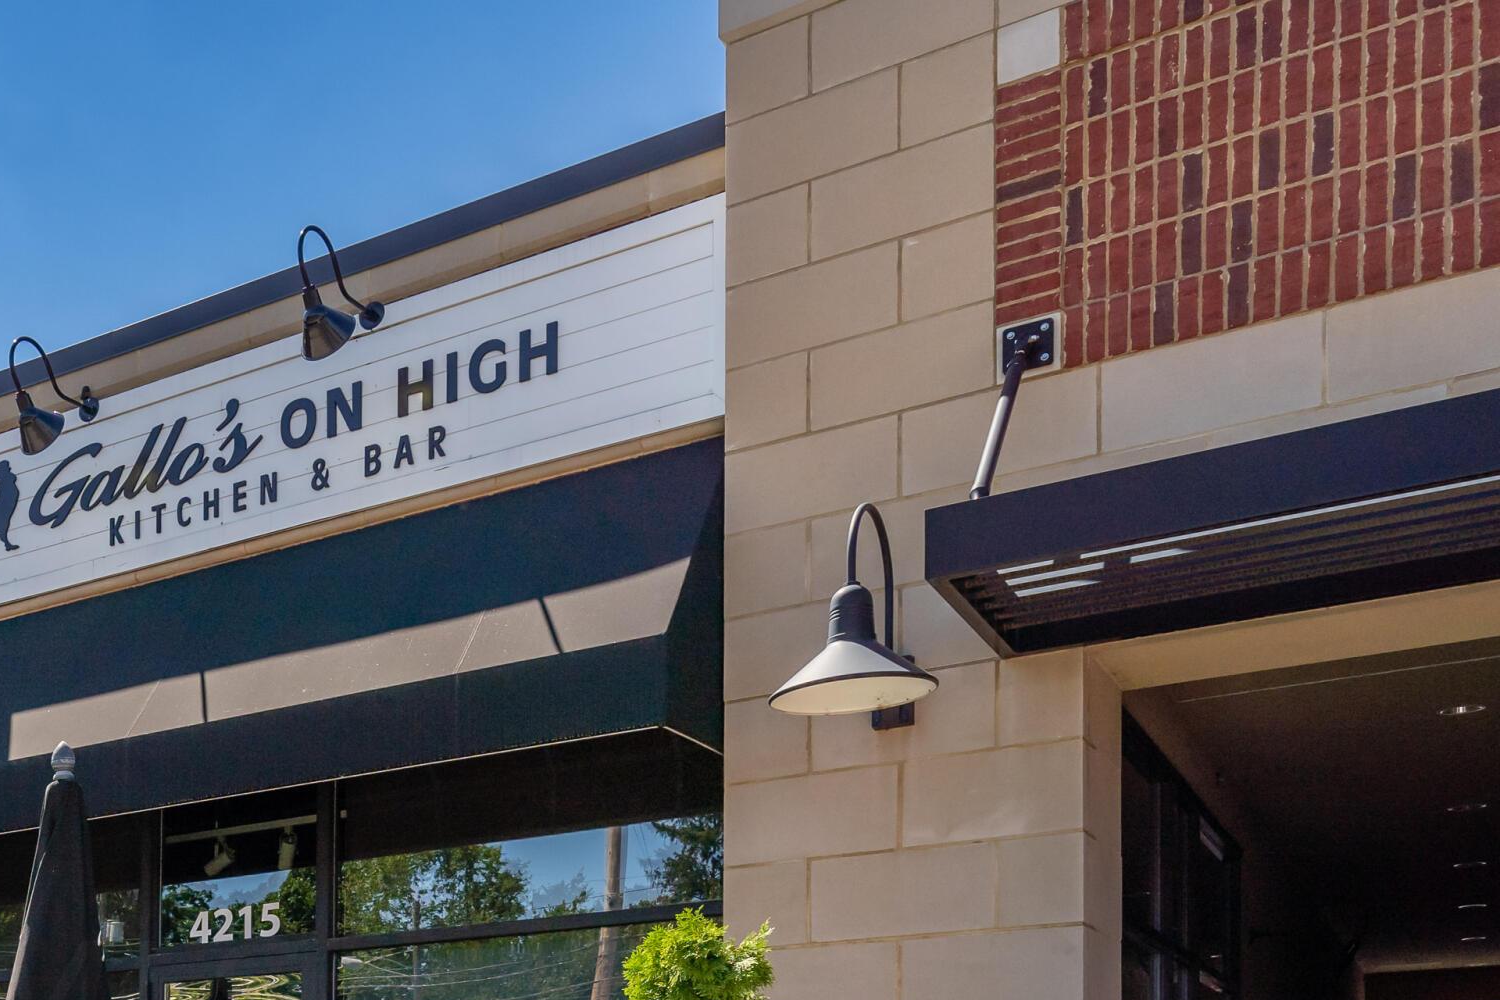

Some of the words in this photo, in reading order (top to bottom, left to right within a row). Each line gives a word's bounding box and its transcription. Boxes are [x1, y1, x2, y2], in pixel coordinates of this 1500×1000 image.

[29, 398, 264, 529] Gallo's
[280, 381, 362, 449] ON
[397, 321, 558, 418] HIGH
[109, 472, 278, 547] KITCHEN
[311, 458, 330, 491] &
[364, 425, 446, 477] BAR
[189, 902, 281, 944] 4215
